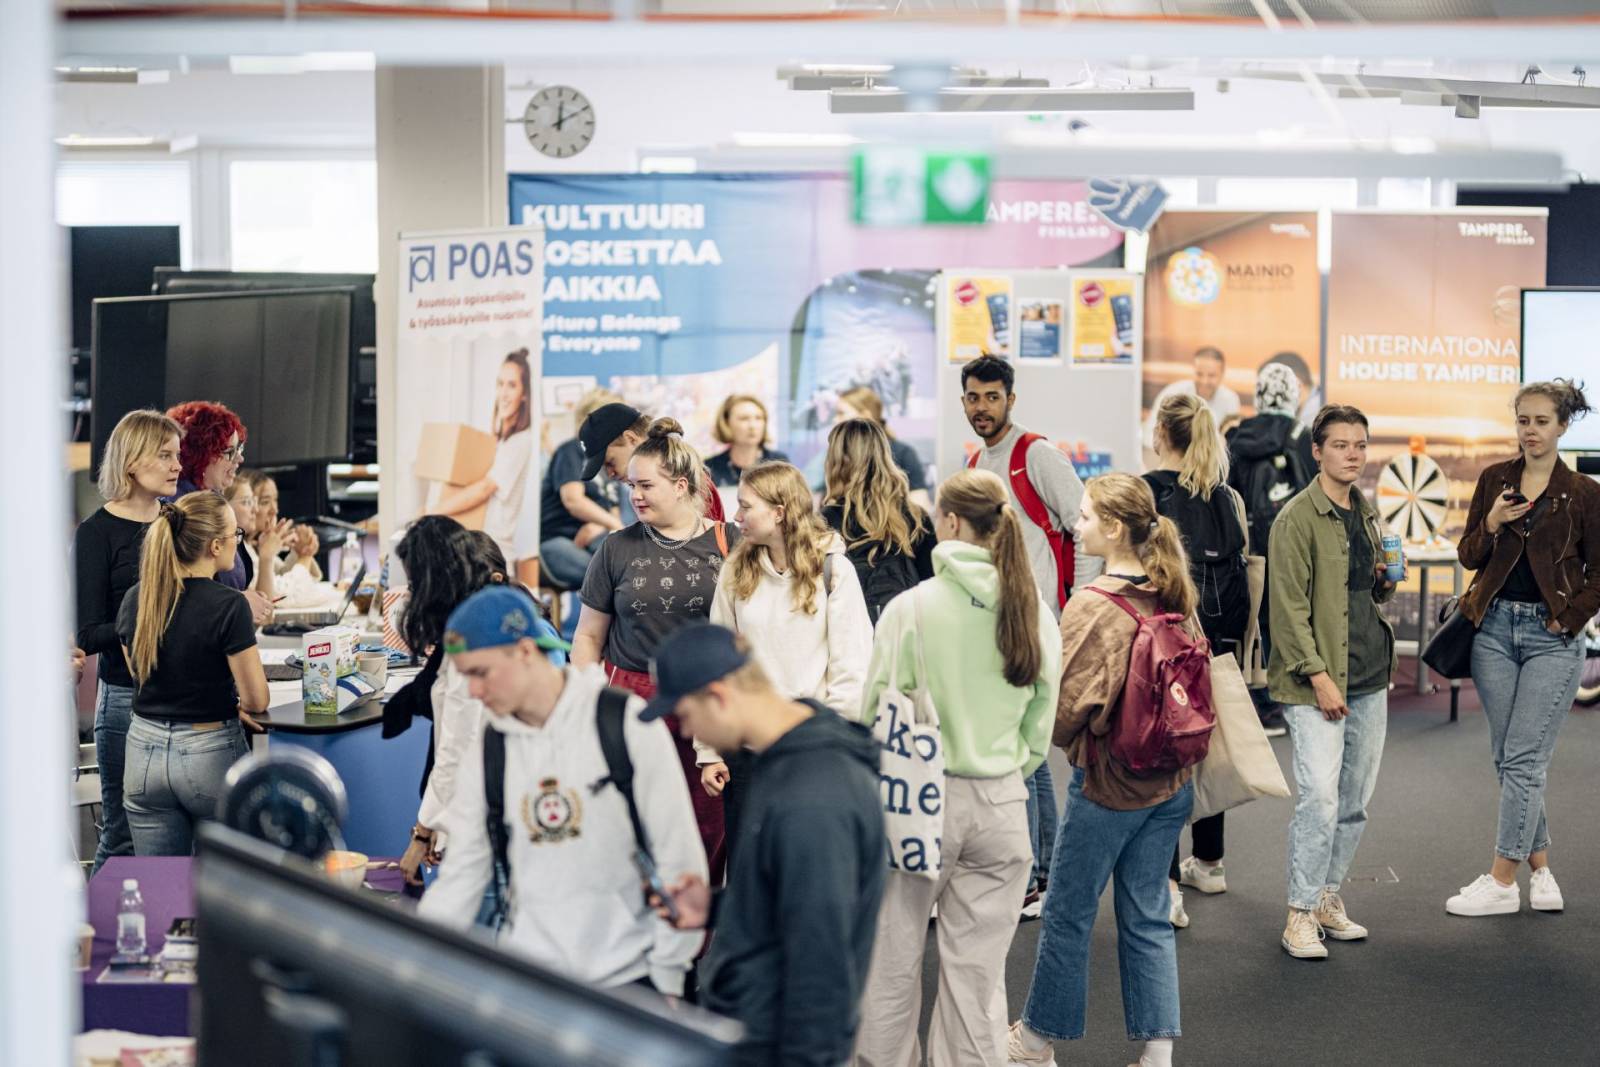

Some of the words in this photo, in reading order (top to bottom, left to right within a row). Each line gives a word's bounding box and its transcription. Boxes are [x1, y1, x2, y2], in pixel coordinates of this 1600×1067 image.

[522, 204, 705, 230] KULTTUURI
[986, 200, 1098, 224] AMPERE.
[1038, 225, 1111, 239] FINLAND
[449, 240, 534, 281] POAS
[544, 239, 722, 267] OSKETTAA
[1227, 264, 1294, 278] MAINIO
[544, 276, 662, 301] AIKKIA
[416, 297, 461, 310] Asuntoja
[601, 313, 682, 334] Belongs
[549, 335, 641, 355] Everyone
[1341, 335, 1519, 358] INTERNATIONA
[1340, 362, 1418, 381] HOUSE
